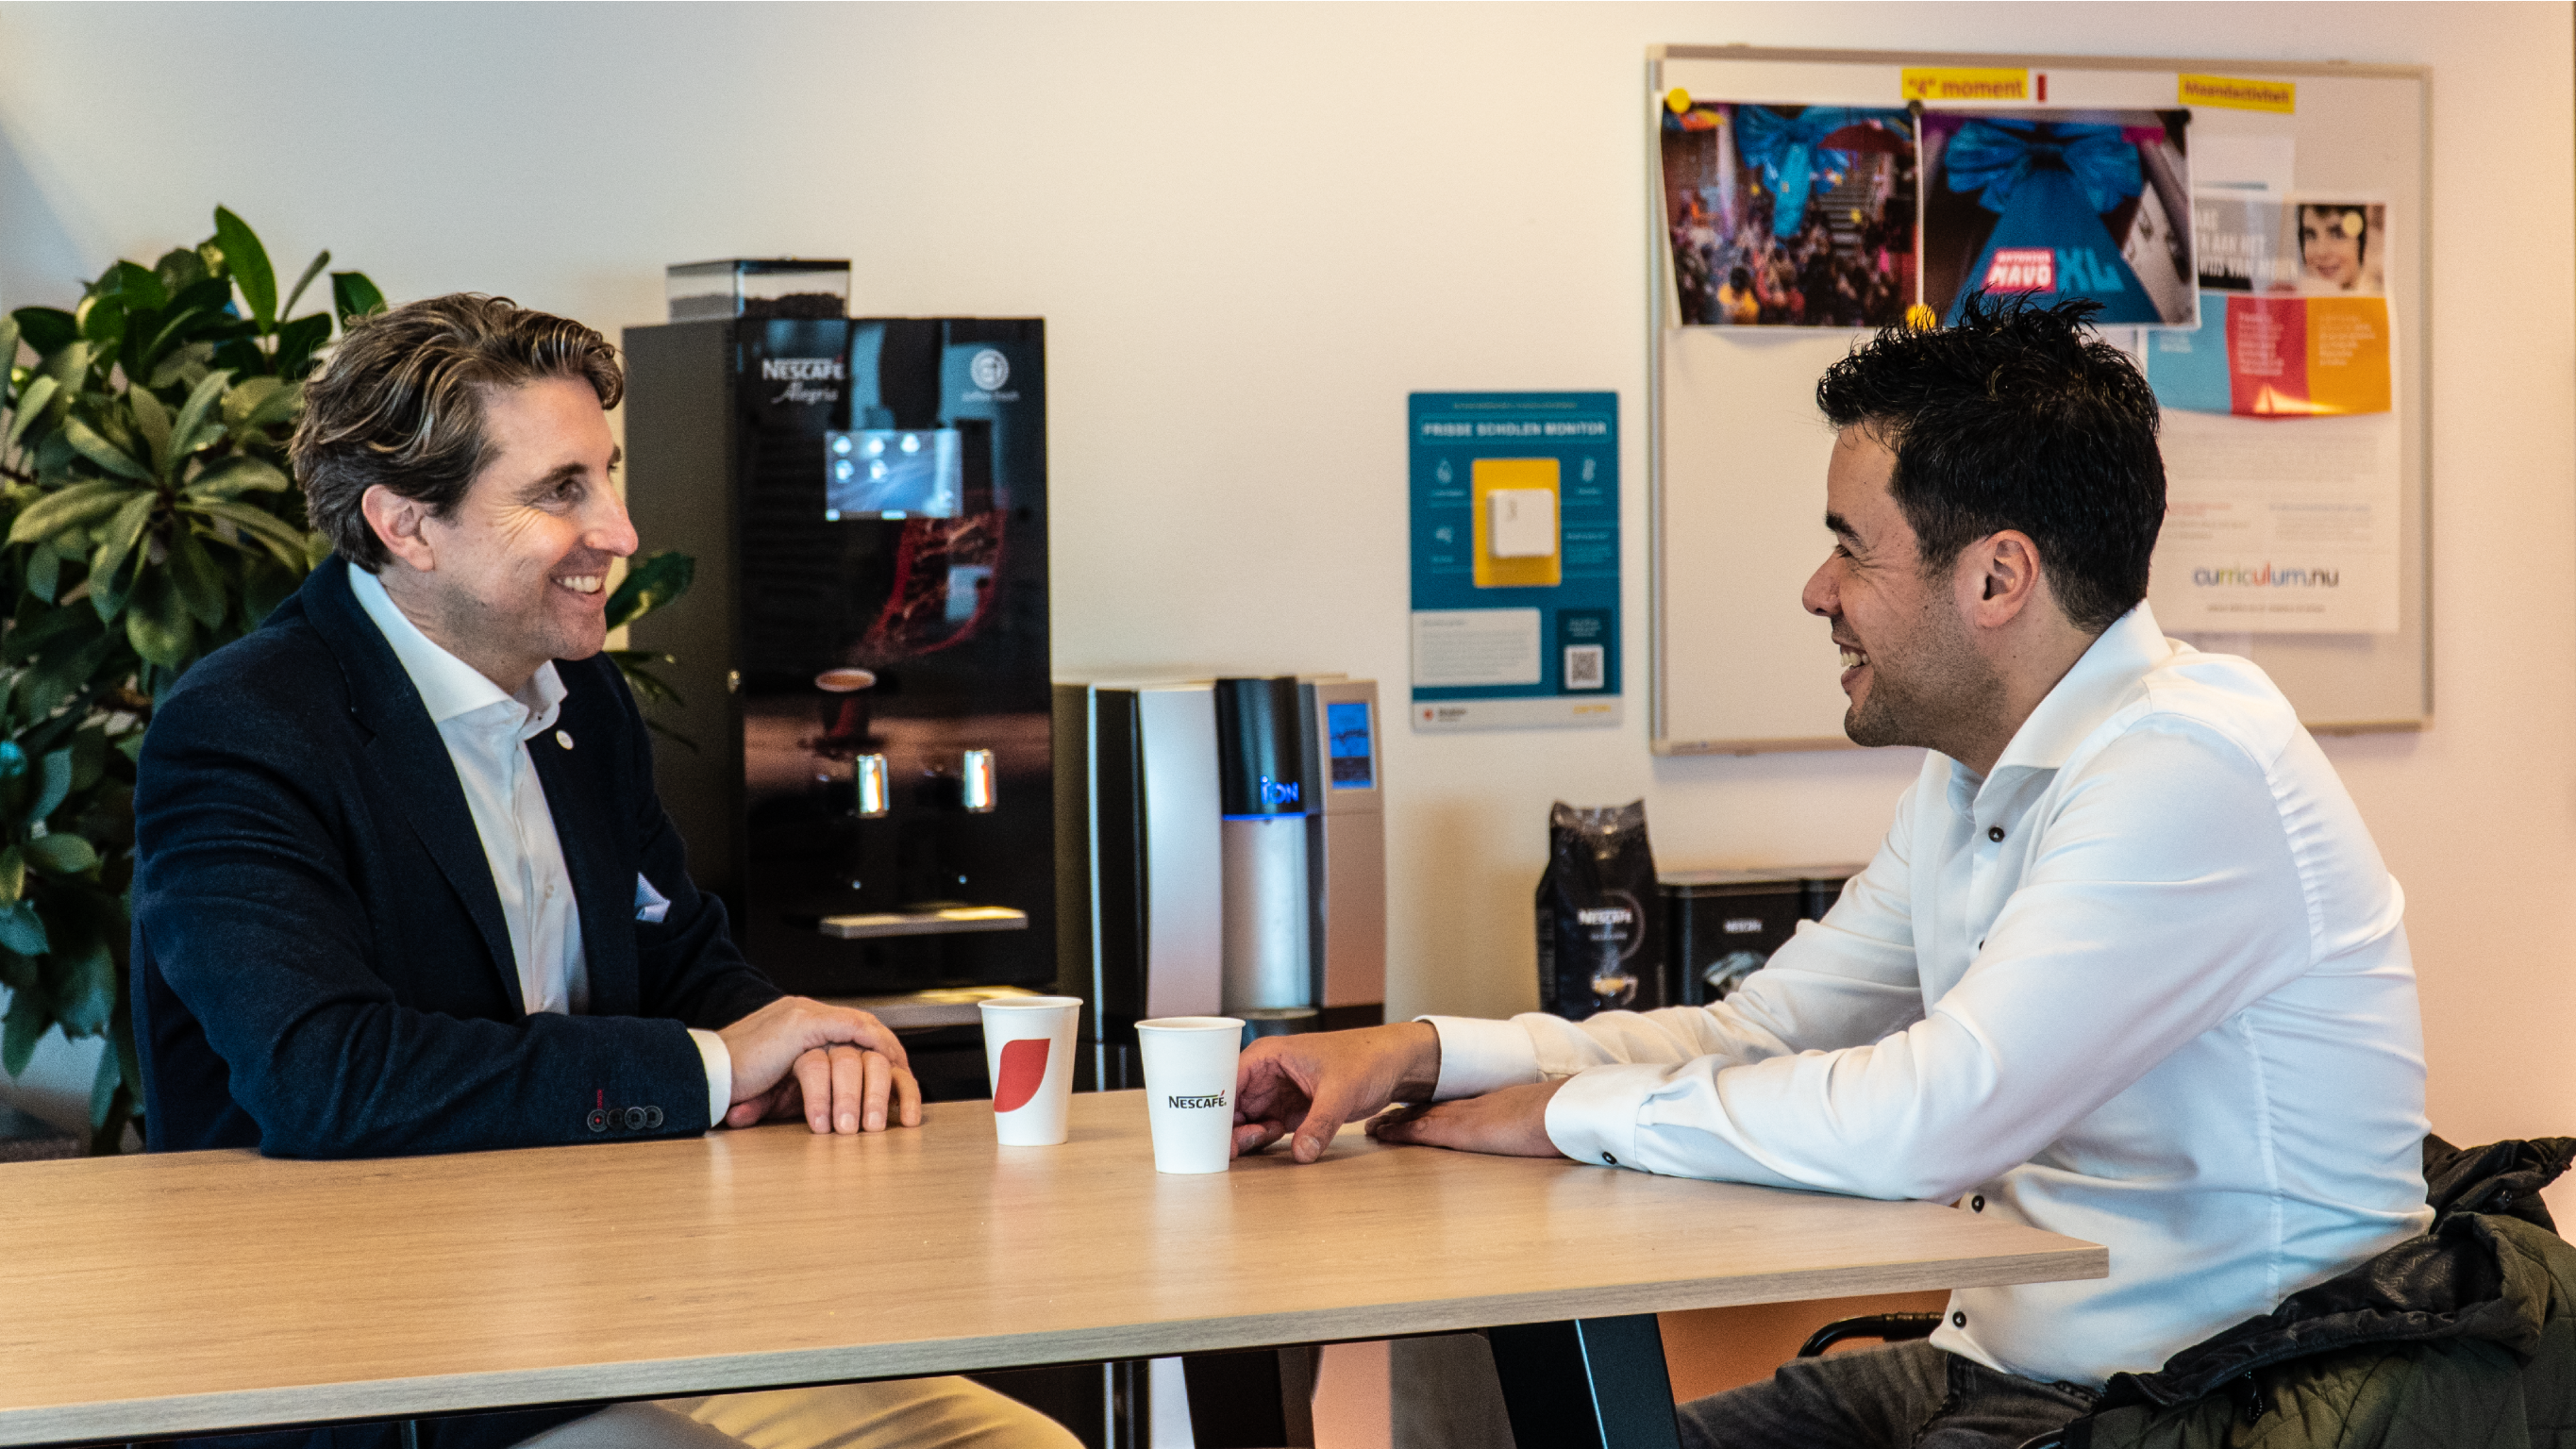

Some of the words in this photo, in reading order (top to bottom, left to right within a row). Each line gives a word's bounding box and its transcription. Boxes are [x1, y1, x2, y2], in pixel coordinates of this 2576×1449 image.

[1942, 79, 2023, 97] moment
[2055, 246, 2123, 294] XL
[1545, 422, 1606, 436] MONITOR
[2193, 560, 2339, 587] curriculum.nu
